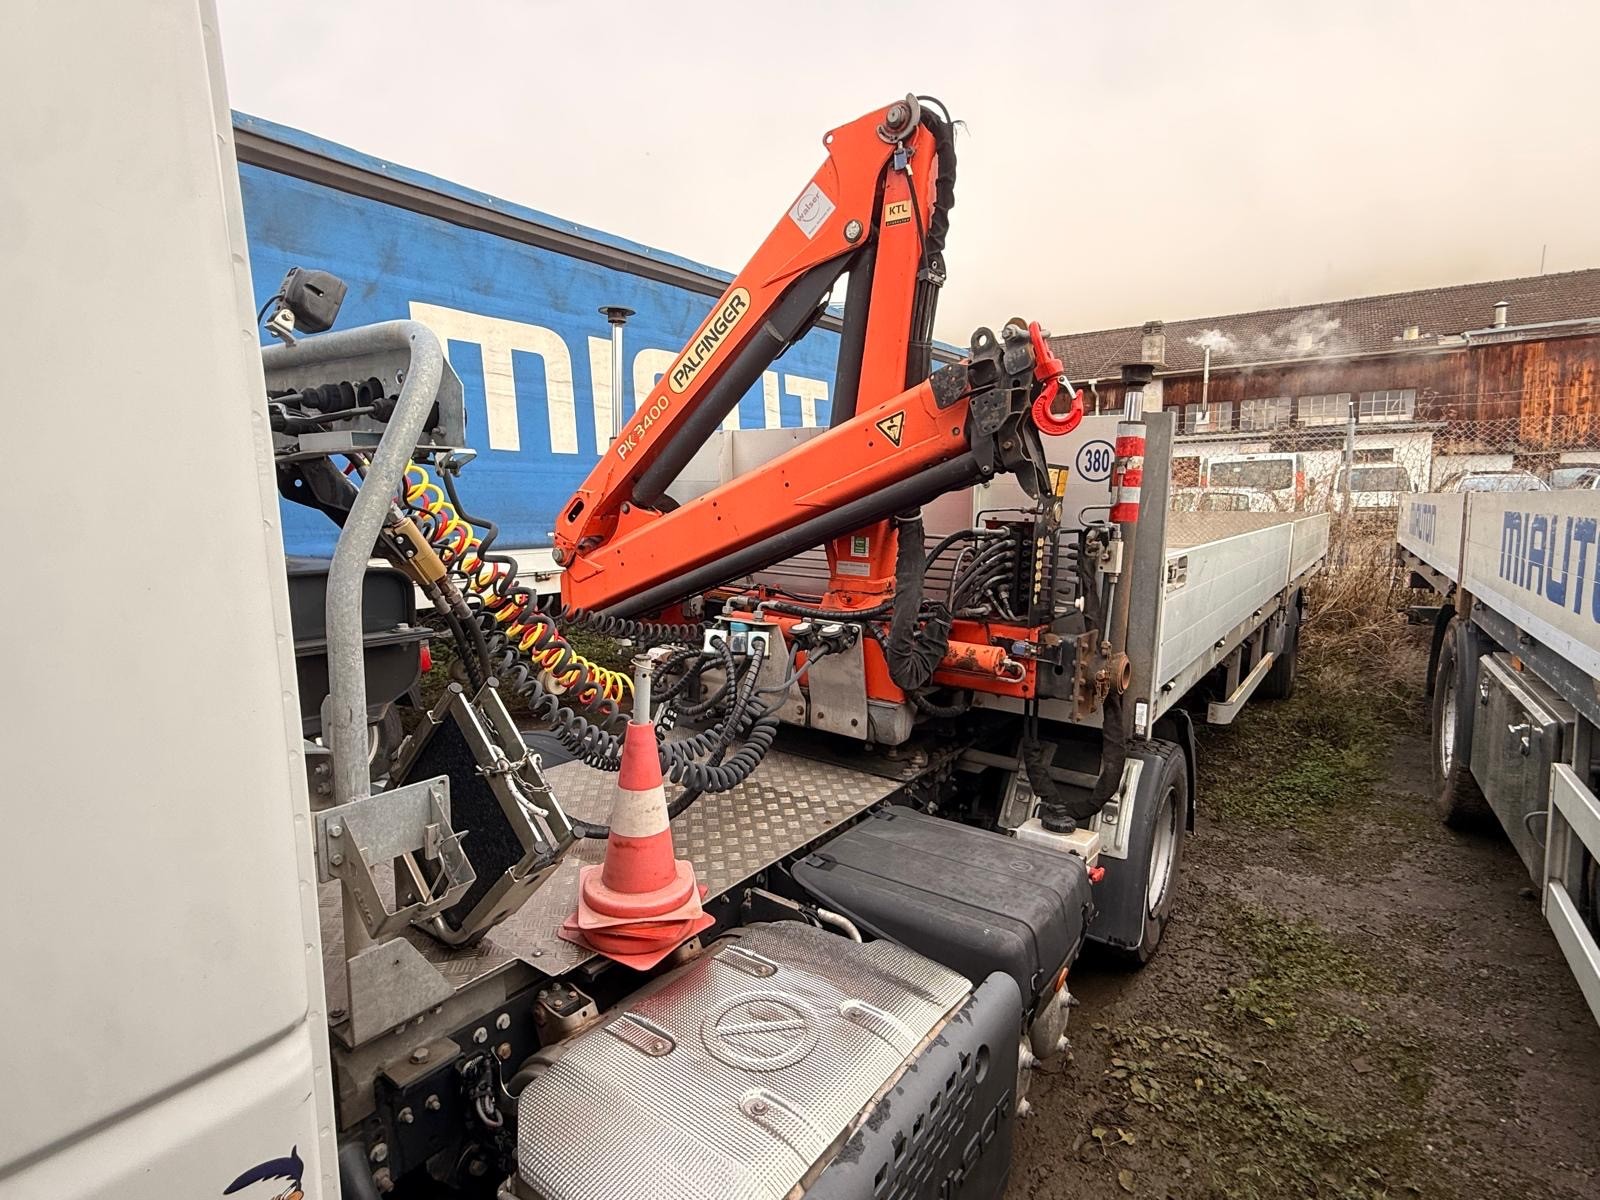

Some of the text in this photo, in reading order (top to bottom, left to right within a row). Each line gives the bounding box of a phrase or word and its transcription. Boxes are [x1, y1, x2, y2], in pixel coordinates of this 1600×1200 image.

[797, 192, 820, 222] walser
[888, 204, 908, 216] KTL
[672, 294, 747, 389] PALFINGER
[616, 395, 670, 461] PK 3400
[1084, 448, 1110, 473] 380
[1499, 511, 1600, 625] MIAUT
